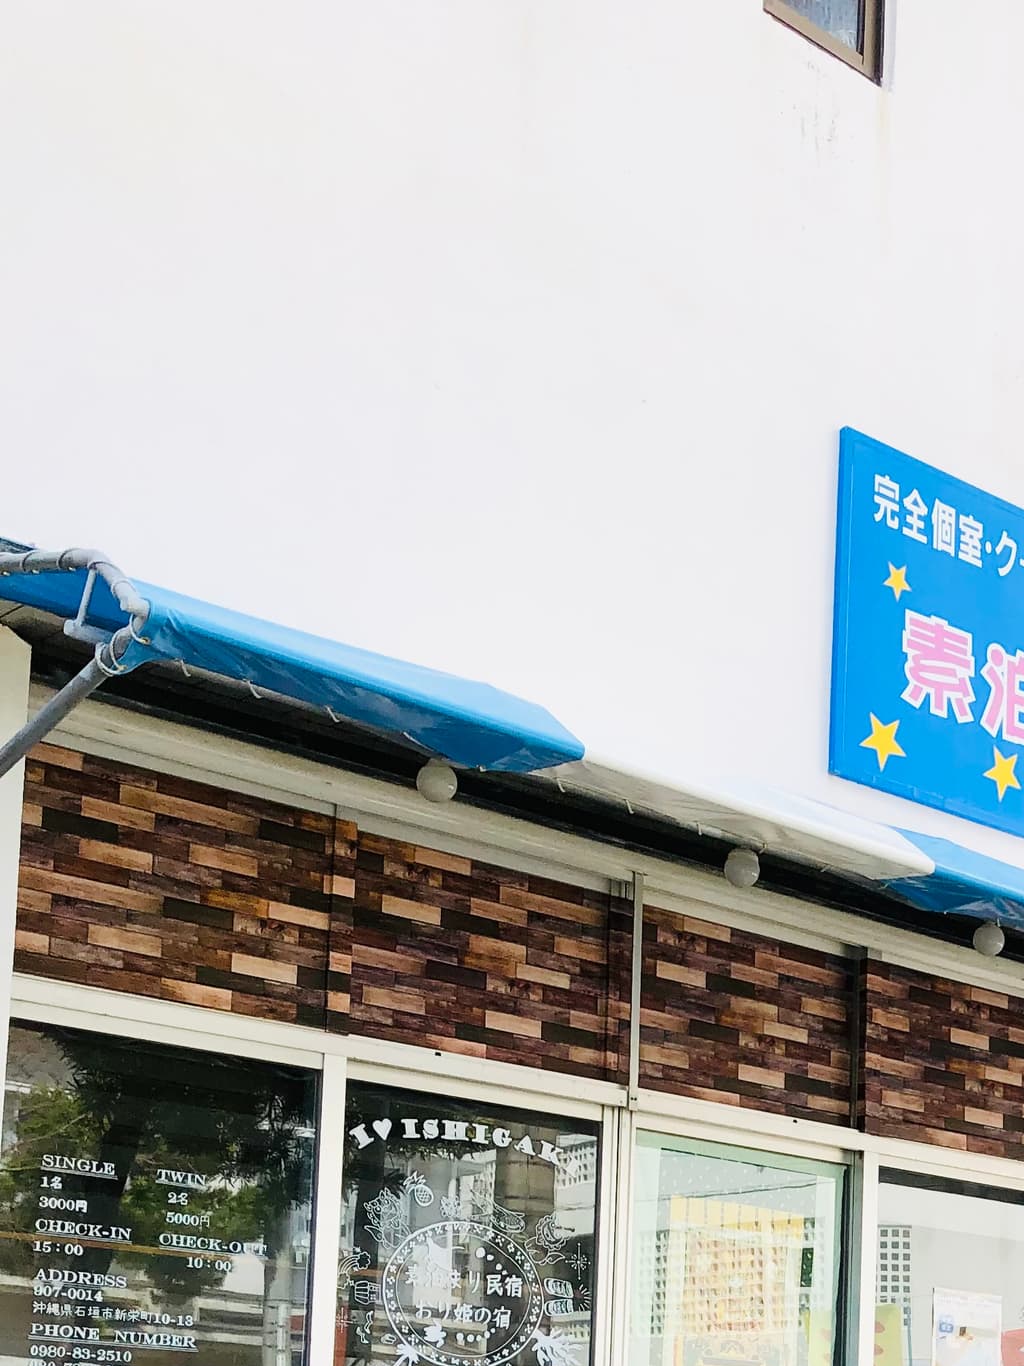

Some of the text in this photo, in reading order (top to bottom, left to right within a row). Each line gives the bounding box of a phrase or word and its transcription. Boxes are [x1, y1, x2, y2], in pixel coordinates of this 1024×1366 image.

[42, 1154, 116, 1176] SINGLE
[39, 1176, 63, 1190] 1名
[156, 1168, 207, 1186] TWIN
[38, 1196, 88, 1213] 3000円
[167, 1191, 189, 1206] 2名
[165, 1211, 210, 1228] 5000円
[35, 1218, 132, 1241] CHECK-IN
[158, 1233, 267, 1256] CHECK-OUT
[34, 1268, 128, 1289] ADDRESS
[33, 1285, 104, 1303] 907-0014
[414, 1299, 512, 1330] おり姫の宿
[29, 1322, 197, 1348] PHONE NUMBER
[29, 1344, 133, 1363] 0980-83-2510
